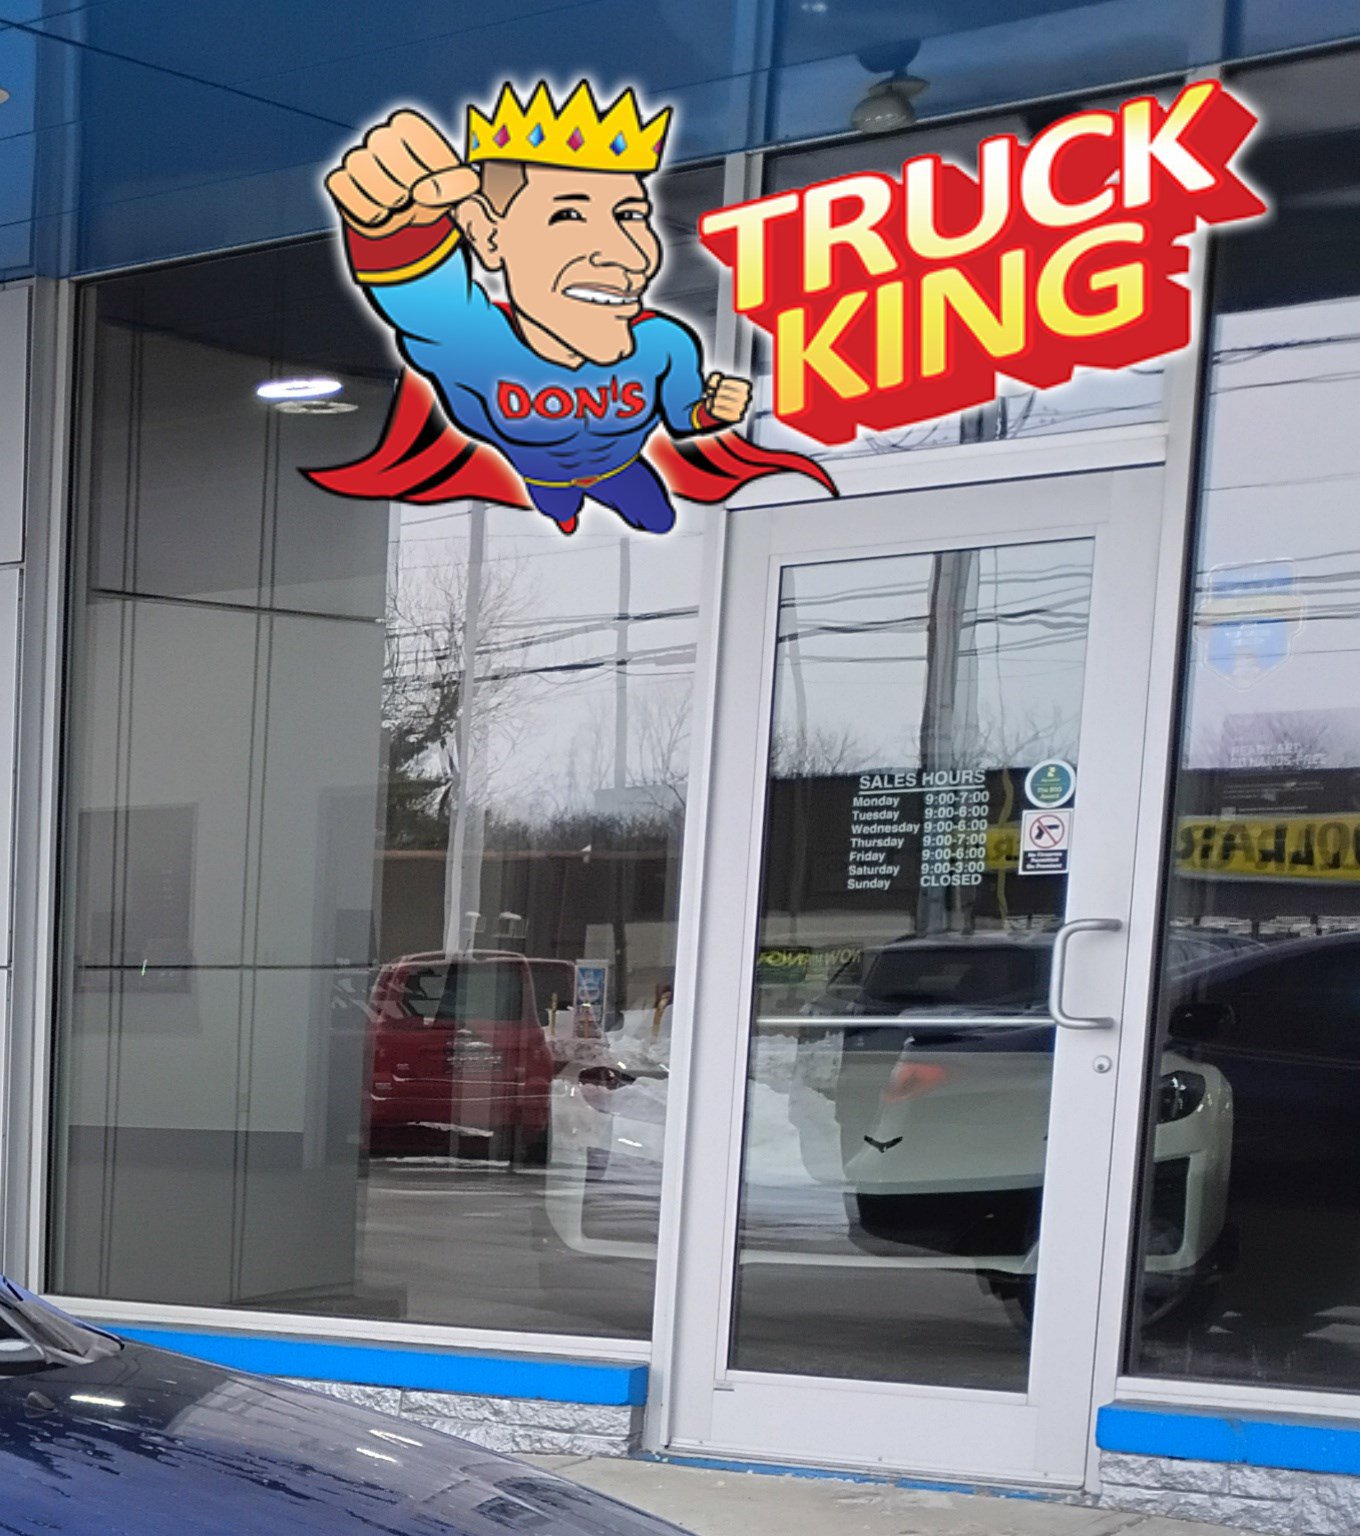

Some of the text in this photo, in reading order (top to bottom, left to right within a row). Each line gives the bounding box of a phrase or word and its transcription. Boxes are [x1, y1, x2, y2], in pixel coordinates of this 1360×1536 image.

[860, 770, 986, 789] SALES HOURS
[853, 791, 989, 807] Monday 9:00-7:00
[852, 805, 989, 821] Tuesday 9:00-6:00
[851, 819, 988, 835] Wednesday 9:00-6:00
[850, 833, 987, 849] Thursday 9:00-7:00
[849, 847, 986, 863] Friday 9:00-6:00
[848, 861, 985, 876] Saturday 9:00-3:00
[847, 874, 982, 891] Sunday CLOSED
